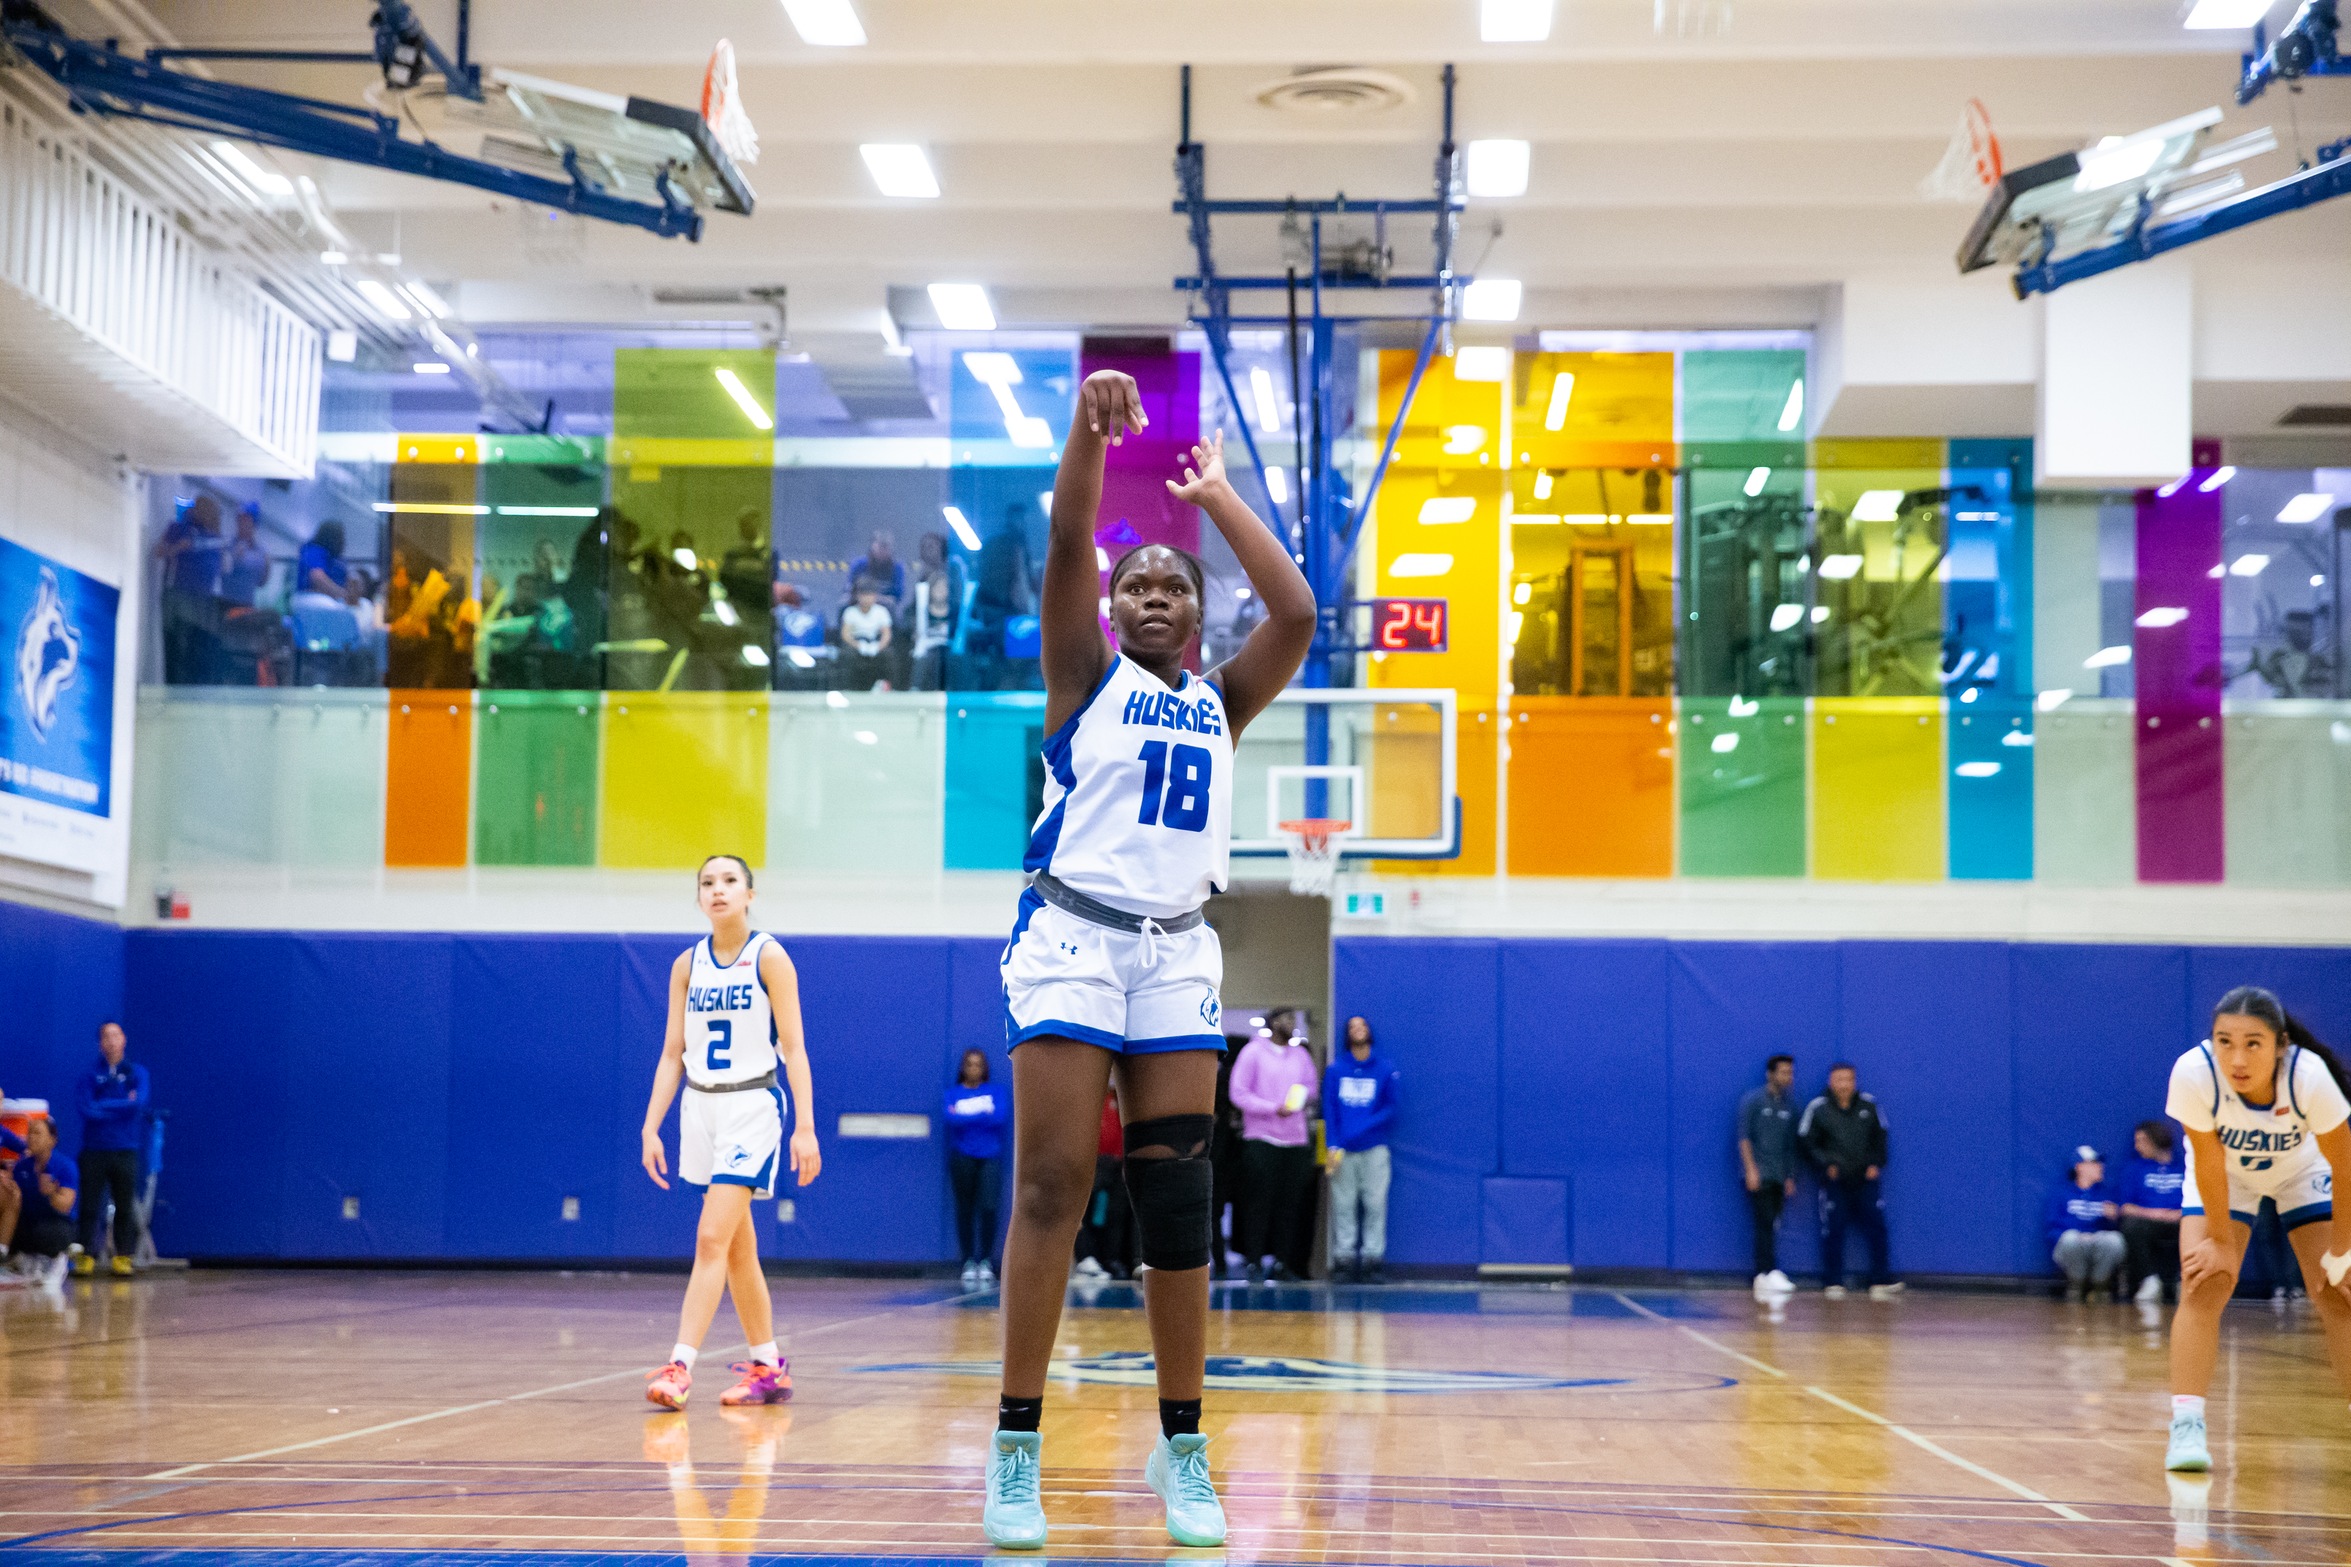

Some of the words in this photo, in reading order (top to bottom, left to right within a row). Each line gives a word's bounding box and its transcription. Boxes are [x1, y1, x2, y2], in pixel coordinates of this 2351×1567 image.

[1382, 602, 1443, 648] 24
[1138, 740, 1212, 832] 18
[688, 984, 753, 1012] HUSKIES
[706, 1019, 732, 1071] 2
